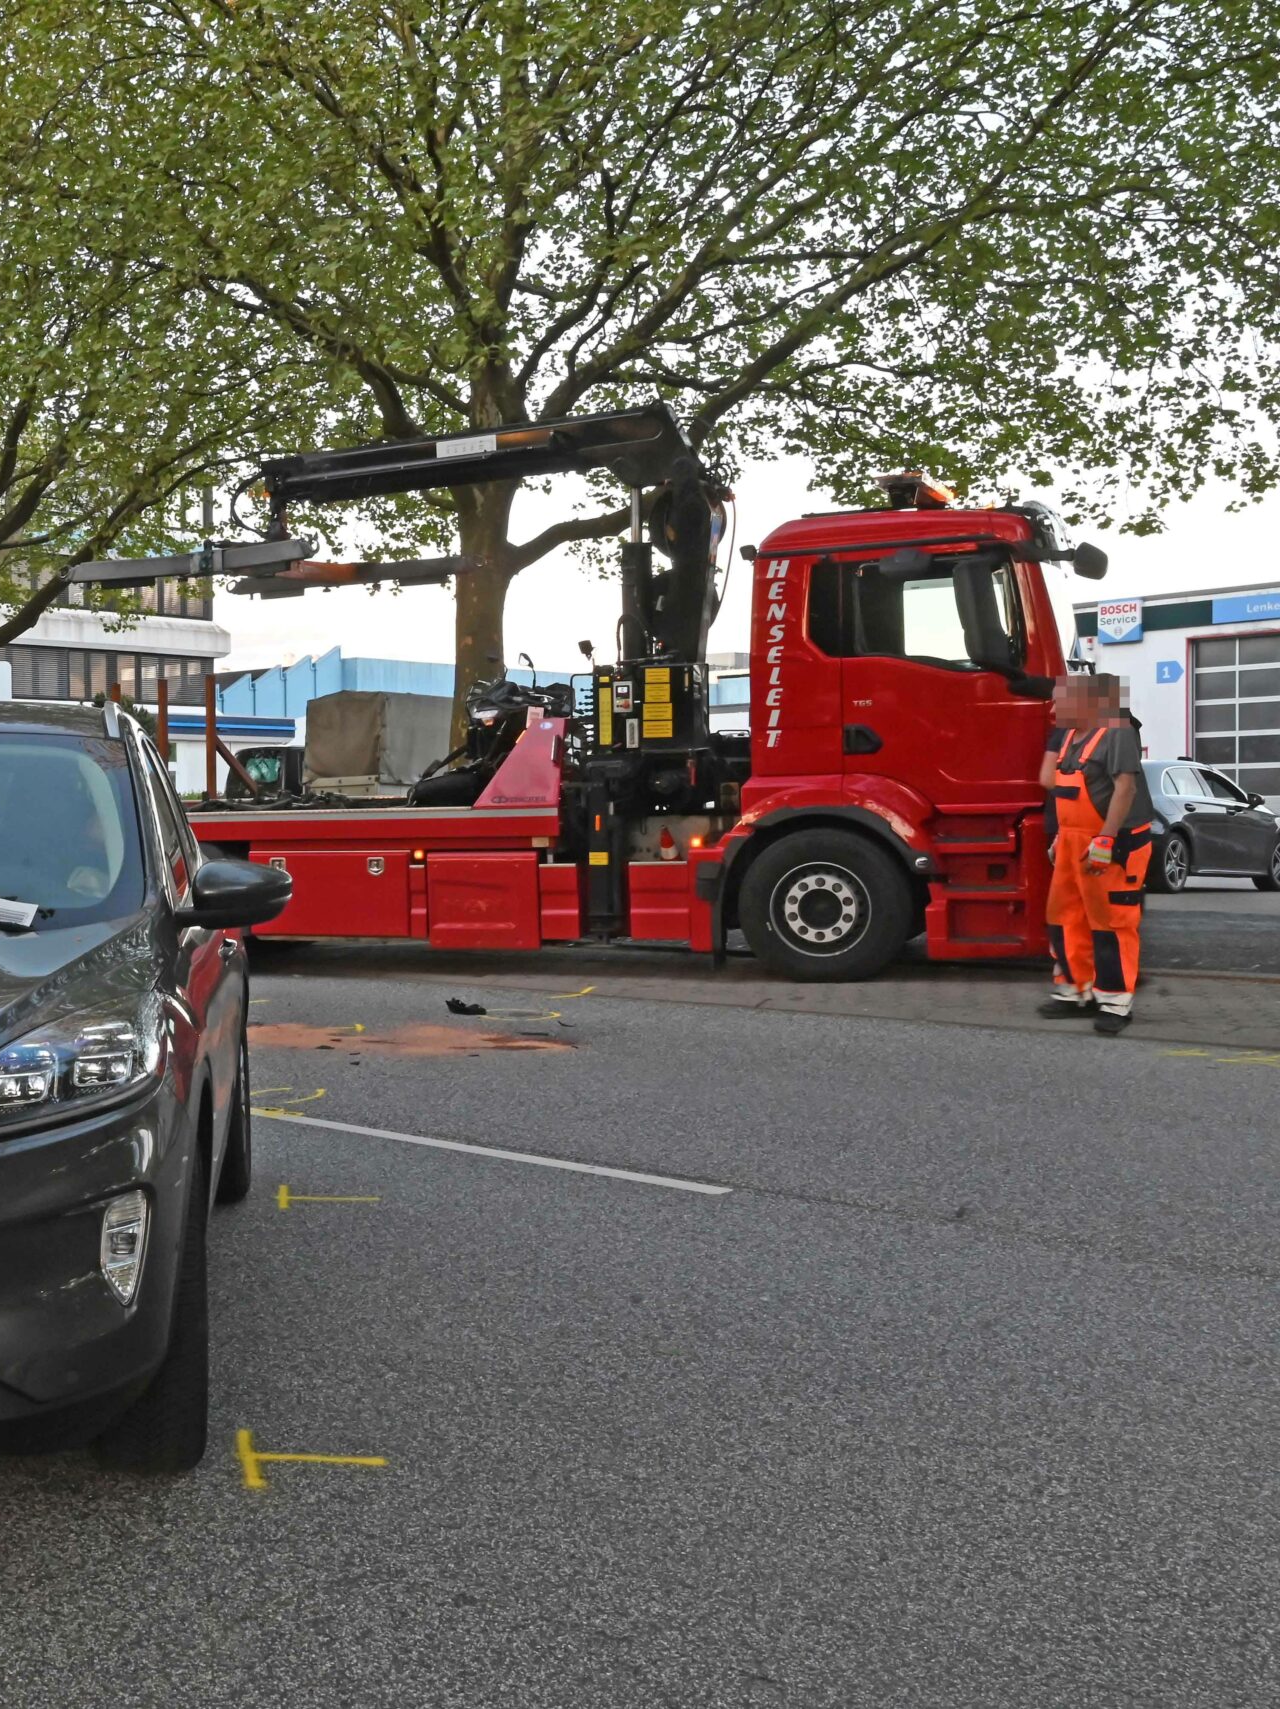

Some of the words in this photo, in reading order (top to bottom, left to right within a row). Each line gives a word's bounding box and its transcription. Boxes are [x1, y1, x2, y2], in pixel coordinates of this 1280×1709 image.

[1100, 603, 1137, 616] BOSCH
[1100, 615, 1137, 626] Service
[766, 560, 790, 747] HENSELEIT
[1162, 666, 1171, 679] 1
[852, 699, 873, 707] TGS
